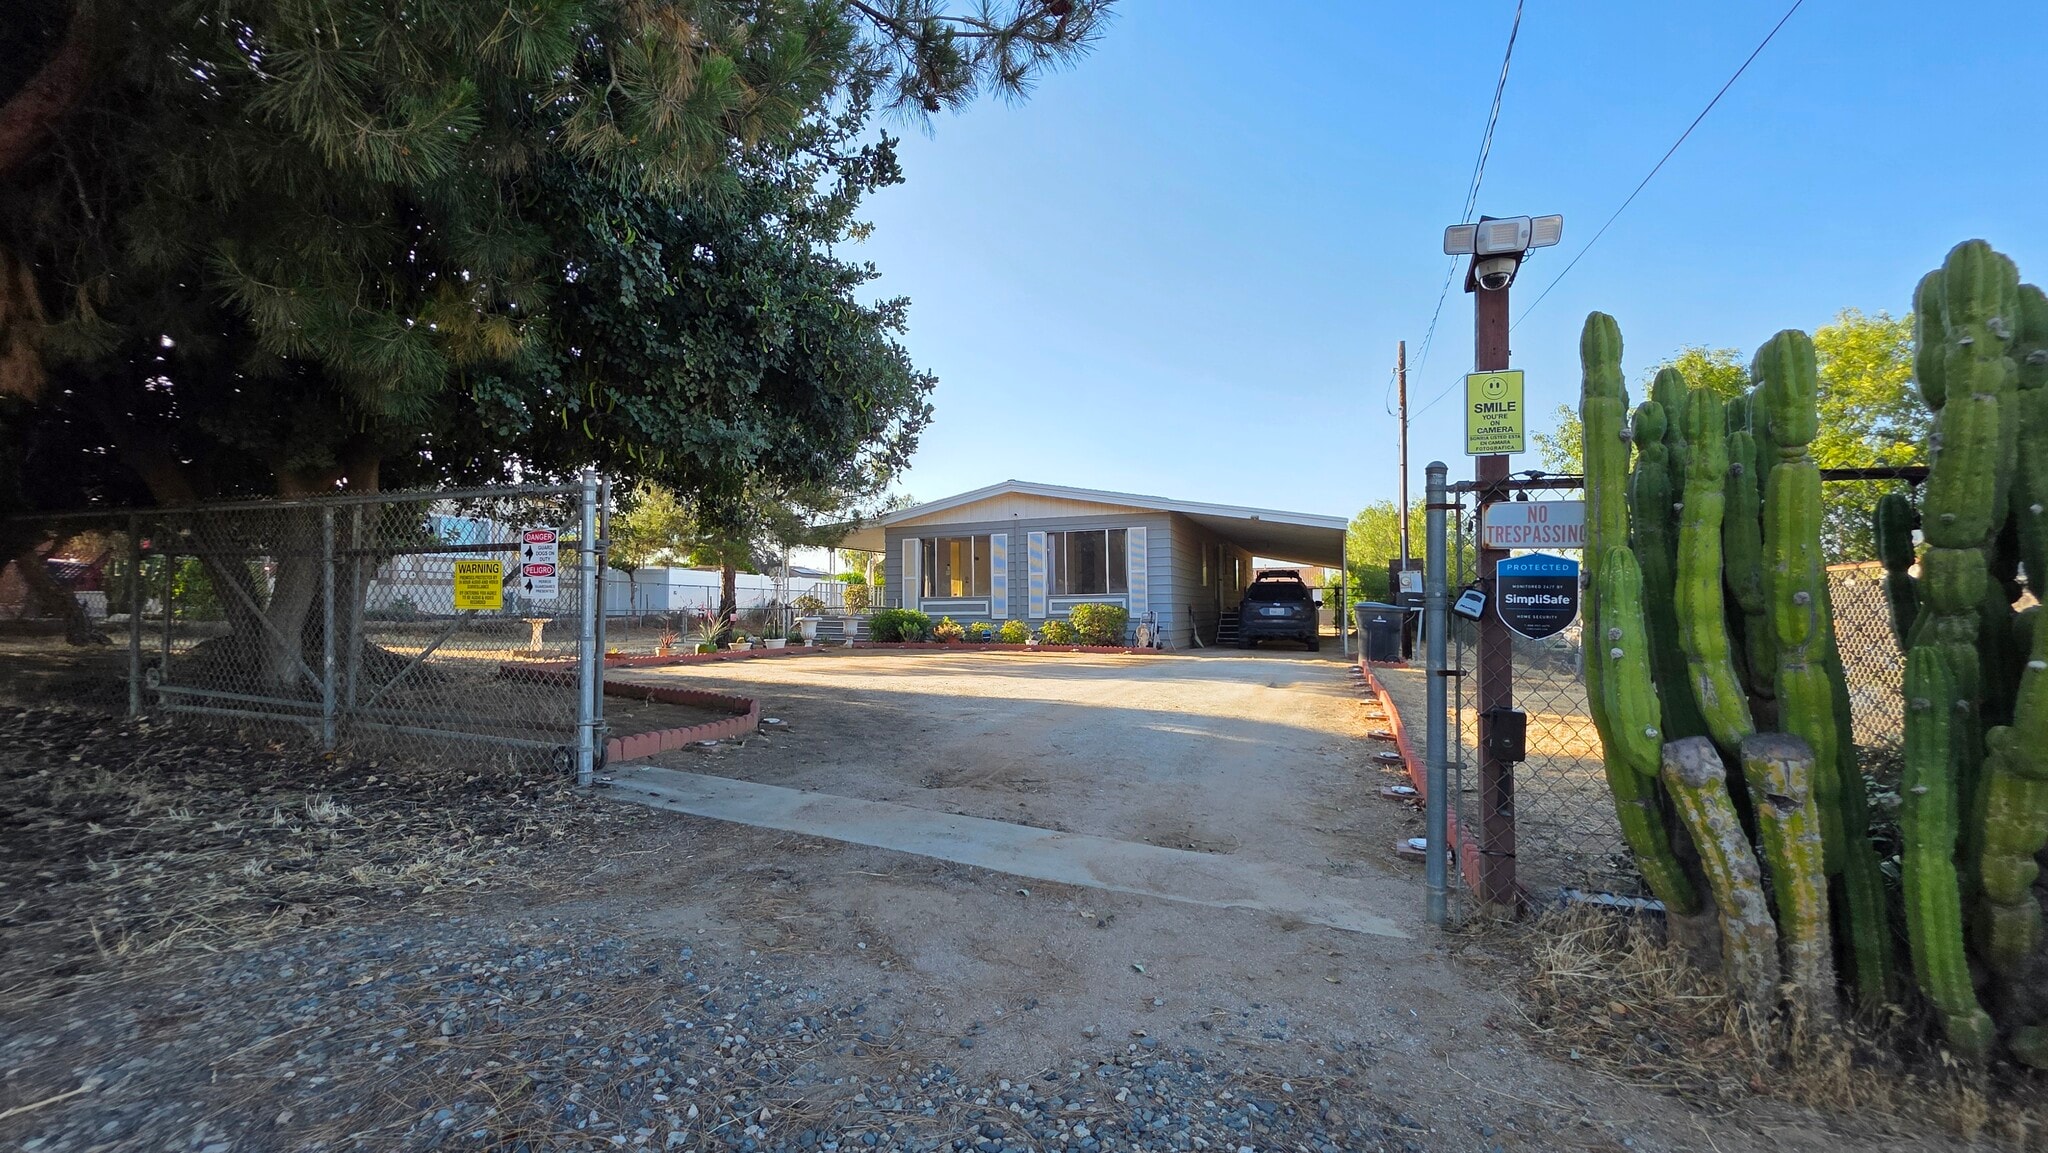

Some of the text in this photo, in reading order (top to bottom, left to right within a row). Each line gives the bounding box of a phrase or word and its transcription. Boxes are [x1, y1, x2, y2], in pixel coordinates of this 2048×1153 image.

[1474, 401, 1516, 413] SMILE
[1477, 426, 1513, 434] CAMERA
[1528, 505, 1548, 523] NO
[526, 533, 552, 541] DANGER
[458, 563, 499, 573] WARNING
[1505, 593, 1570, 606] SimpliSafe
